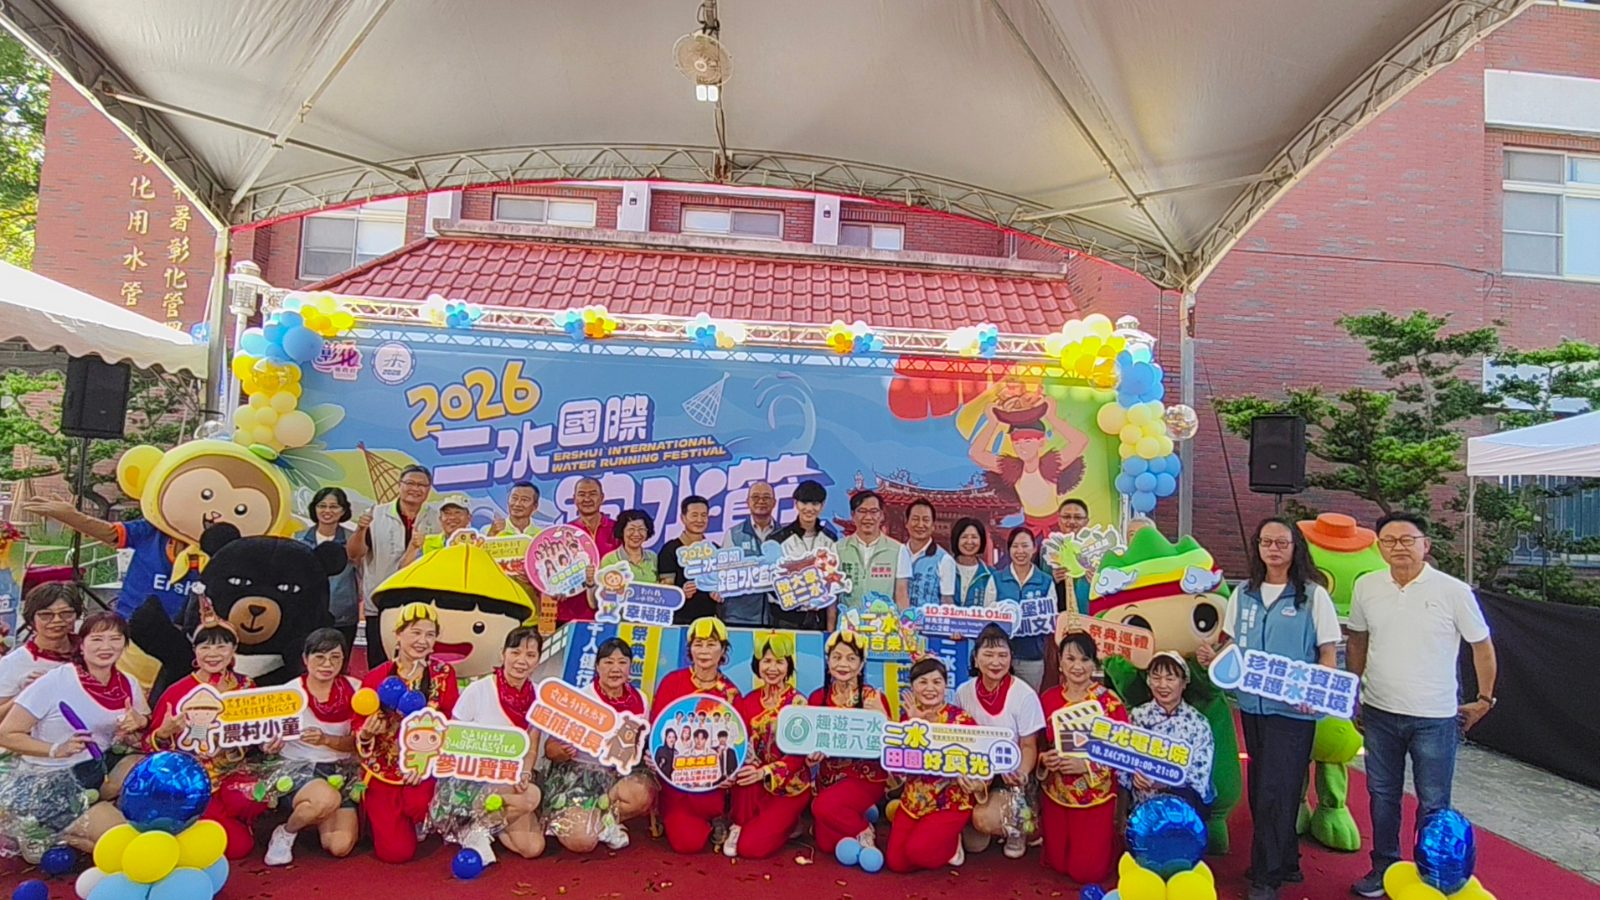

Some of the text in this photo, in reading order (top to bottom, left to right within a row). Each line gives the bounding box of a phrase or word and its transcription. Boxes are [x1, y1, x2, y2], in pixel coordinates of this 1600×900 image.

[407, 361, 541, 438] 2026
[556, 395, 649, 446] 國際
[433, 423, 553, 485] 二水
[551, 445, 727, 473] WATER RUNNING FESTIVAL
[553, 436, 716, 462] ERSHUI INTERNATIONAL
[680, 543, 714, 562] 2026
[687, 559, 717, 575] 二水
[626, 604, 671, 624] 幸福猴
[1088, 624, 1149, 650] 祭典巡禮
[1246, 653, 1353, 694] 珍惜水資源
[1243, 671, 1349, 714] 保護水環境
[223, 716, 301, 743] 農村小童
[531, 703, 604, 754] 喔熊組長
[815, 714, 882, 733] 趣遊二水
[884, 721, 929, 748] 二水
[814, 733, 882, 750] 農憶八堡
[1090, 719, 1190, 767] 星光電影院
[436, 753, 520, 781] 參山寶寶
